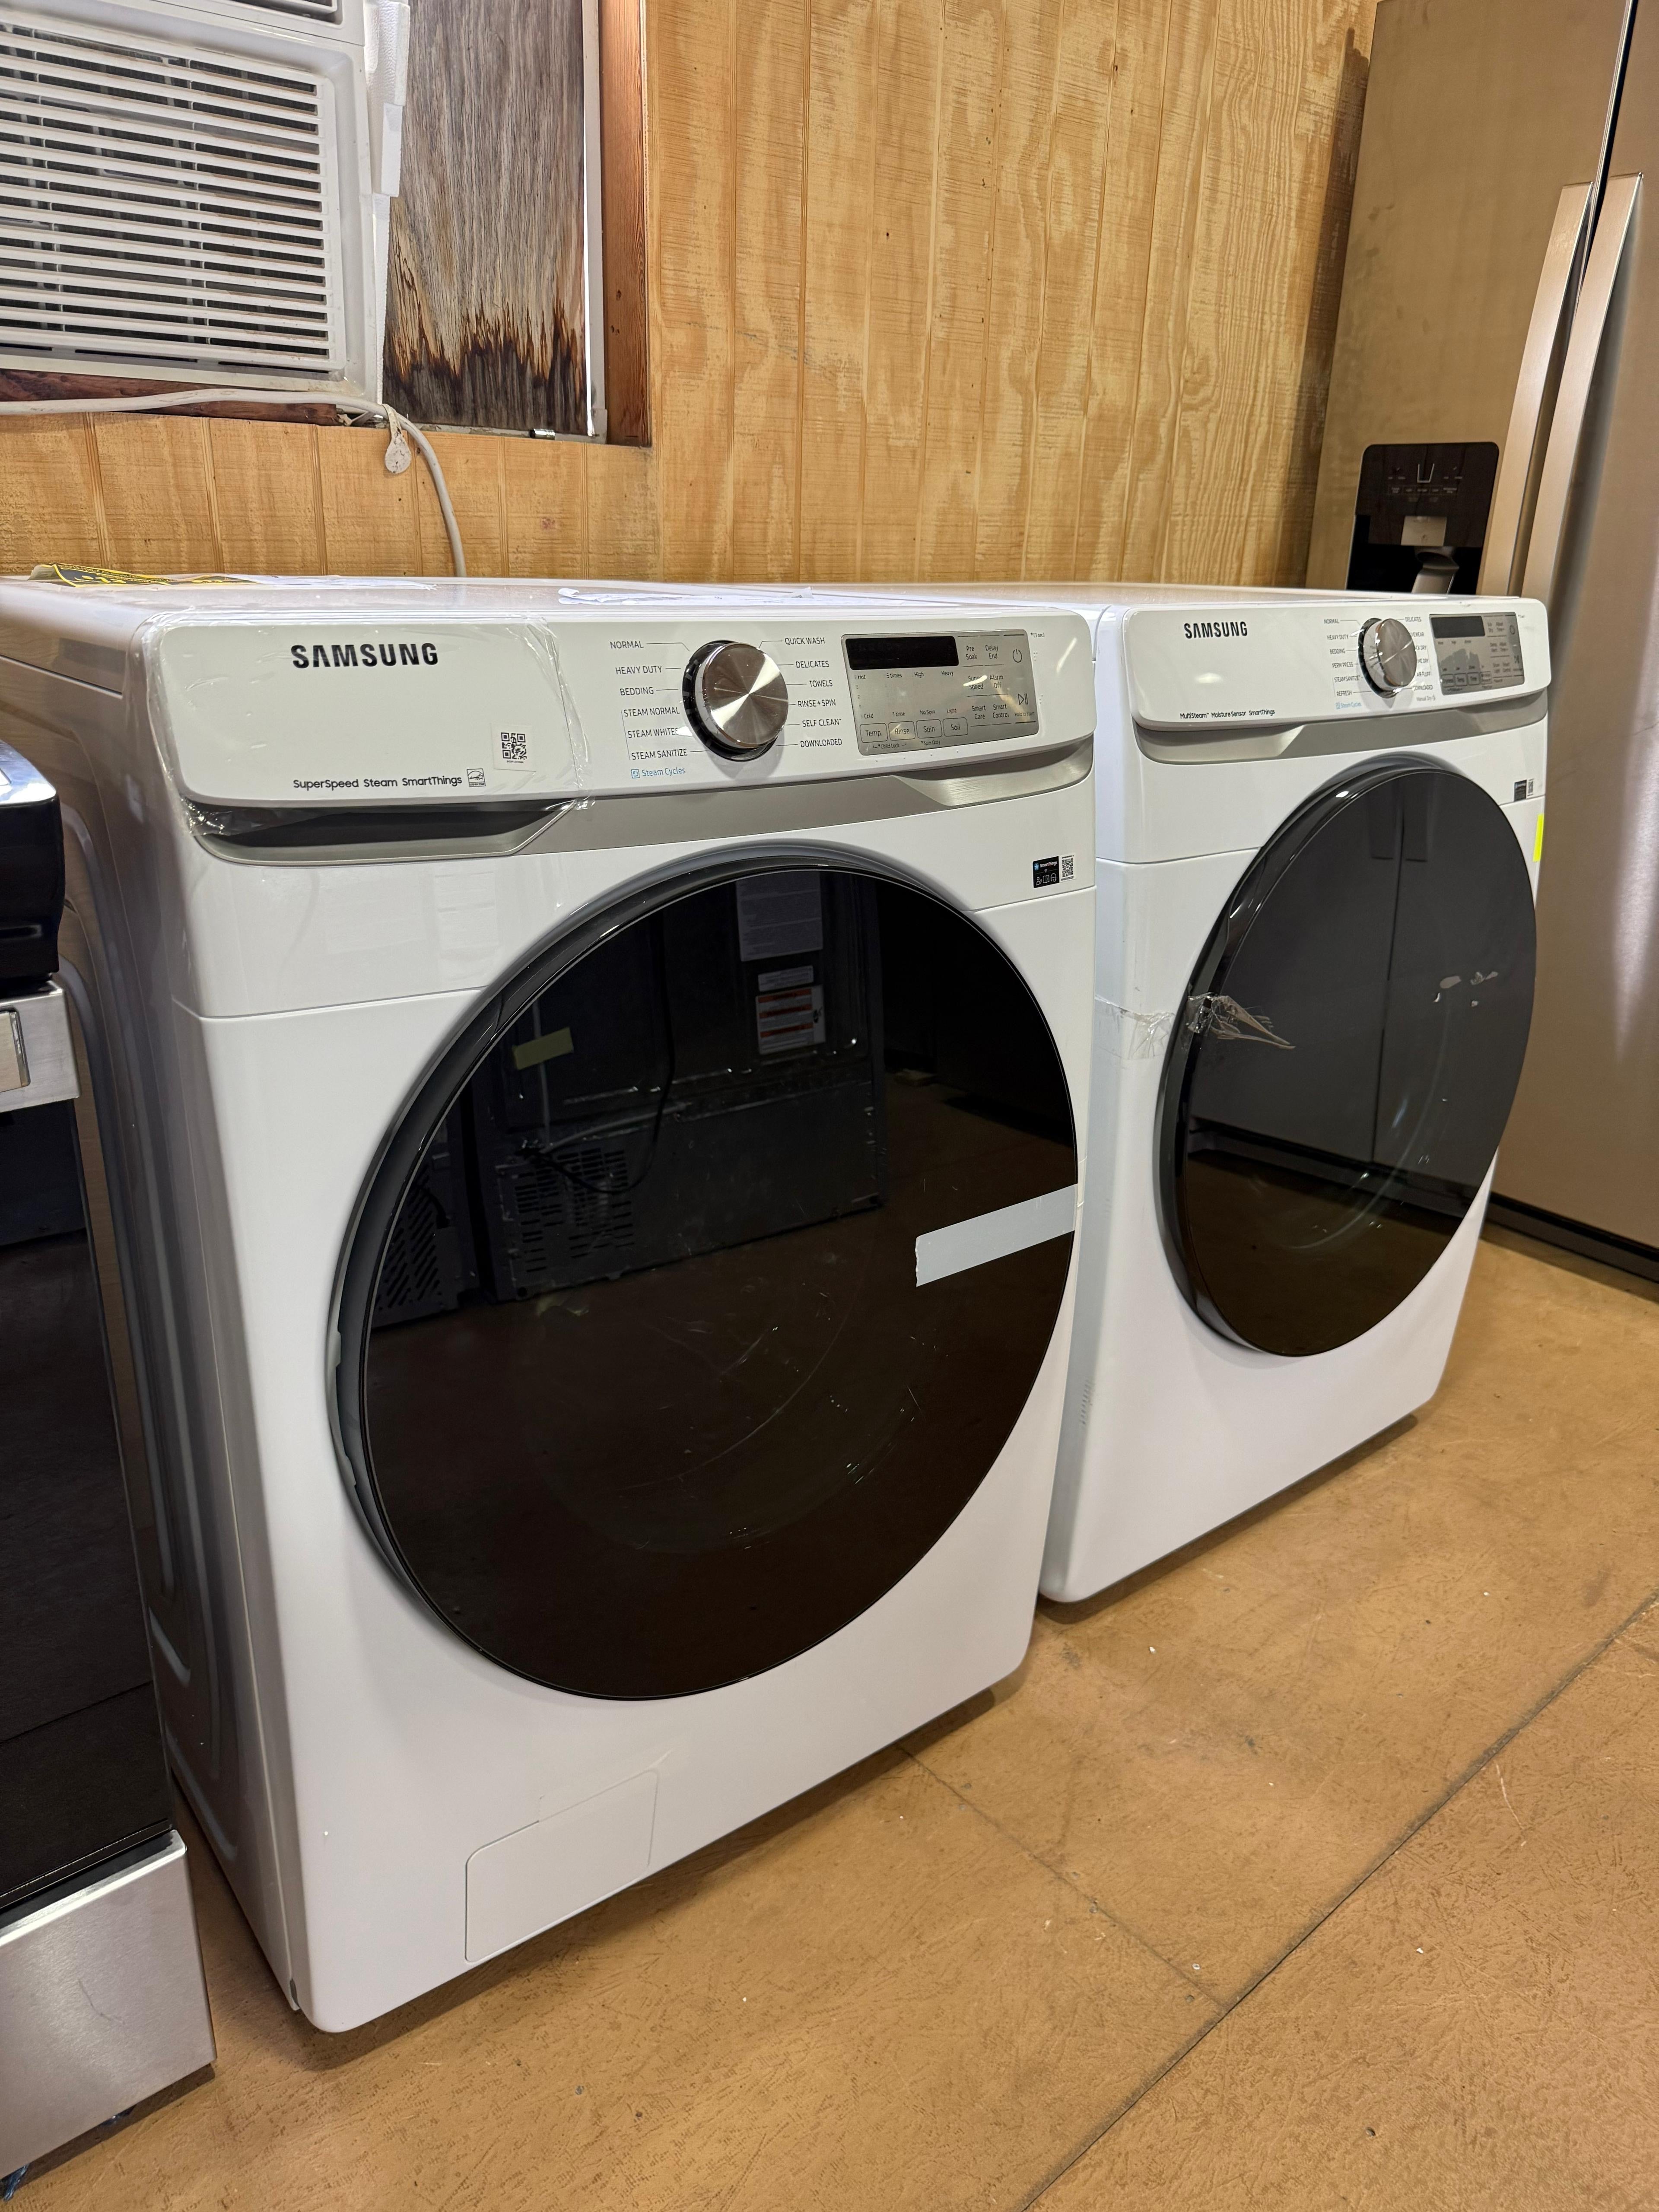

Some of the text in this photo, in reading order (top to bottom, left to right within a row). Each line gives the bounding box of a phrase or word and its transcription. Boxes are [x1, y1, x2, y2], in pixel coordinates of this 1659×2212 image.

[1184, 621, 1248, 639] SAMSUNG
[610, 641, 644, 649] NORMAL
[785, 637, 805, 645] QUICK
[291, 642, 439, 669] SAMSUNG
[615, 665, 662, 674] HEAVY DUTY
[620, 686, 654, 696] BEDDING
[623, 707, 680, 717] STEAM NORMAL
[627, 729, 652, 738] STEAM
[923, 725, 935, 734] Spin
[800, 738, 842, 748] DOWNLOADED
[631, 748, 688, 760] STEAM SANITIZE
[664, 767, 686, 776] Cycles
[293, 775, 462, 791] SuperSpeed Steam SmartThings
